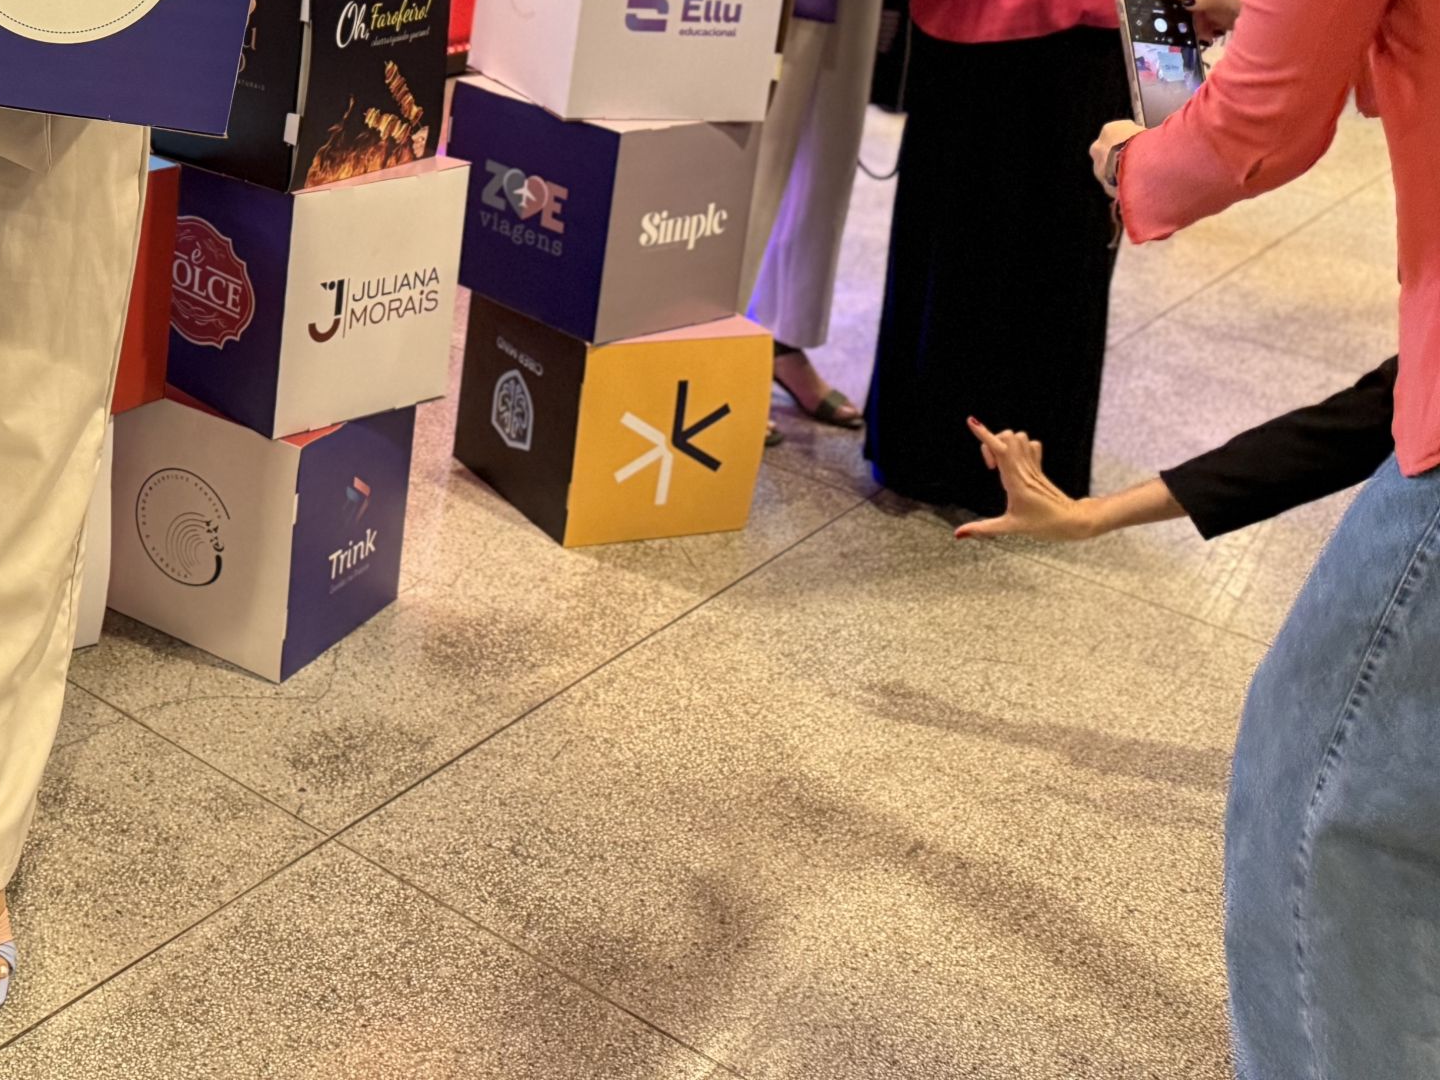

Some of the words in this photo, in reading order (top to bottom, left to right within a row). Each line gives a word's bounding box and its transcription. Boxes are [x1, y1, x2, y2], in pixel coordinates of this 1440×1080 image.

[679, 27, 737, 38] educacional
[479, 210, 564, 257] viagens
[639, 203, 729, 251] Simple
[172, 259, 242, 313] OLCE
[352, 267, 441, 302] JULIANA
[328, 528, 378, 580] Trink
